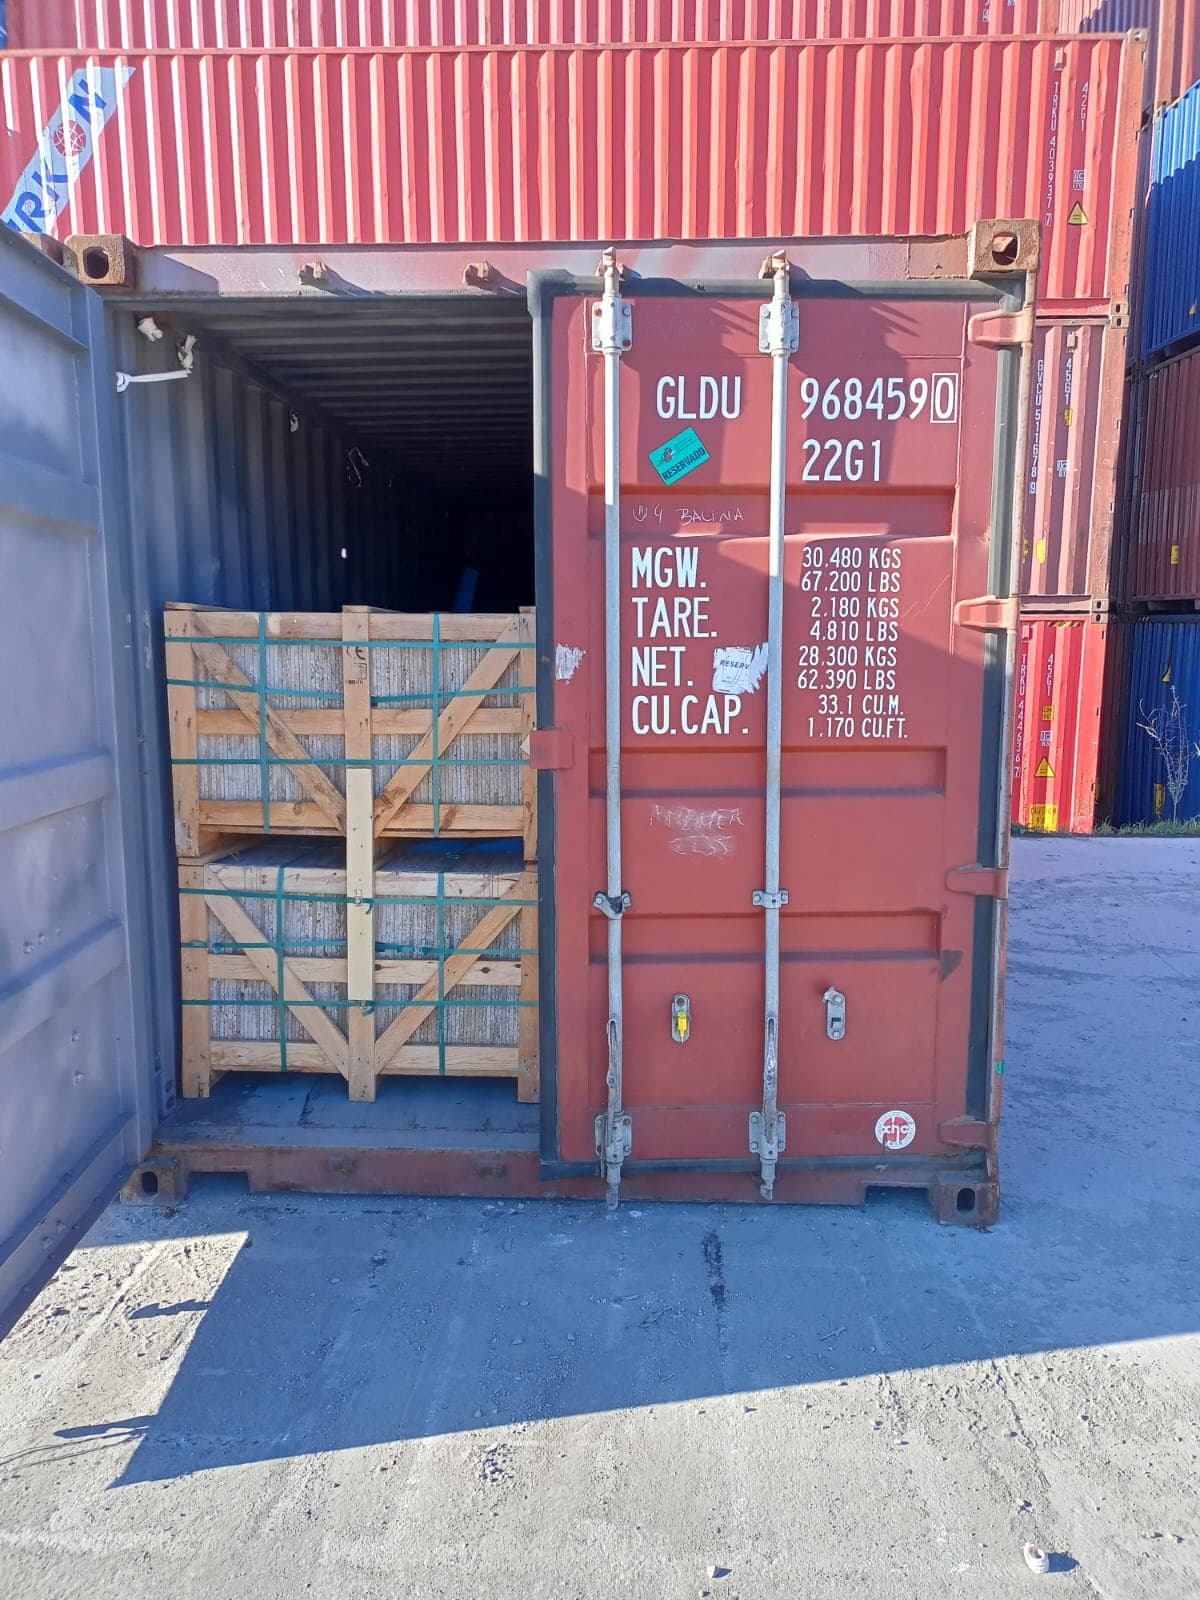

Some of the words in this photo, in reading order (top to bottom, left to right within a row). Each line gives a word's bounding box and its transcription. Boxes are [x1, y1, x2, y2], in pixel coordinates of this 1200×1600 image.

[656, 376, 741, 419] GLDU
[802, 439, 881, 481] 22G1
[1031, 409, 1041, 477] 511678
[662, 447, 706, 481] RESERVADO
[631, 547, 706, 588] MGW.
[869, 547, 901, 569] KGS
[868, 571, 900, 593] LBS
[631, 597, 717, 638] TARE.
[867, 597, 900, 618] KGS
[866, 620, 898, 642] LBS
[631, 646, 694, 687] NET.
[865, 646, 897, 667] KGS
[863, 669, 896, 690] LBS
[632, 694, 749, 735] CU.CAP.
[818, 694, 853, 715] 33.1
[862, 694, 904, 715] CU.M.
[861, 717, 908, 738] CU.FT.
